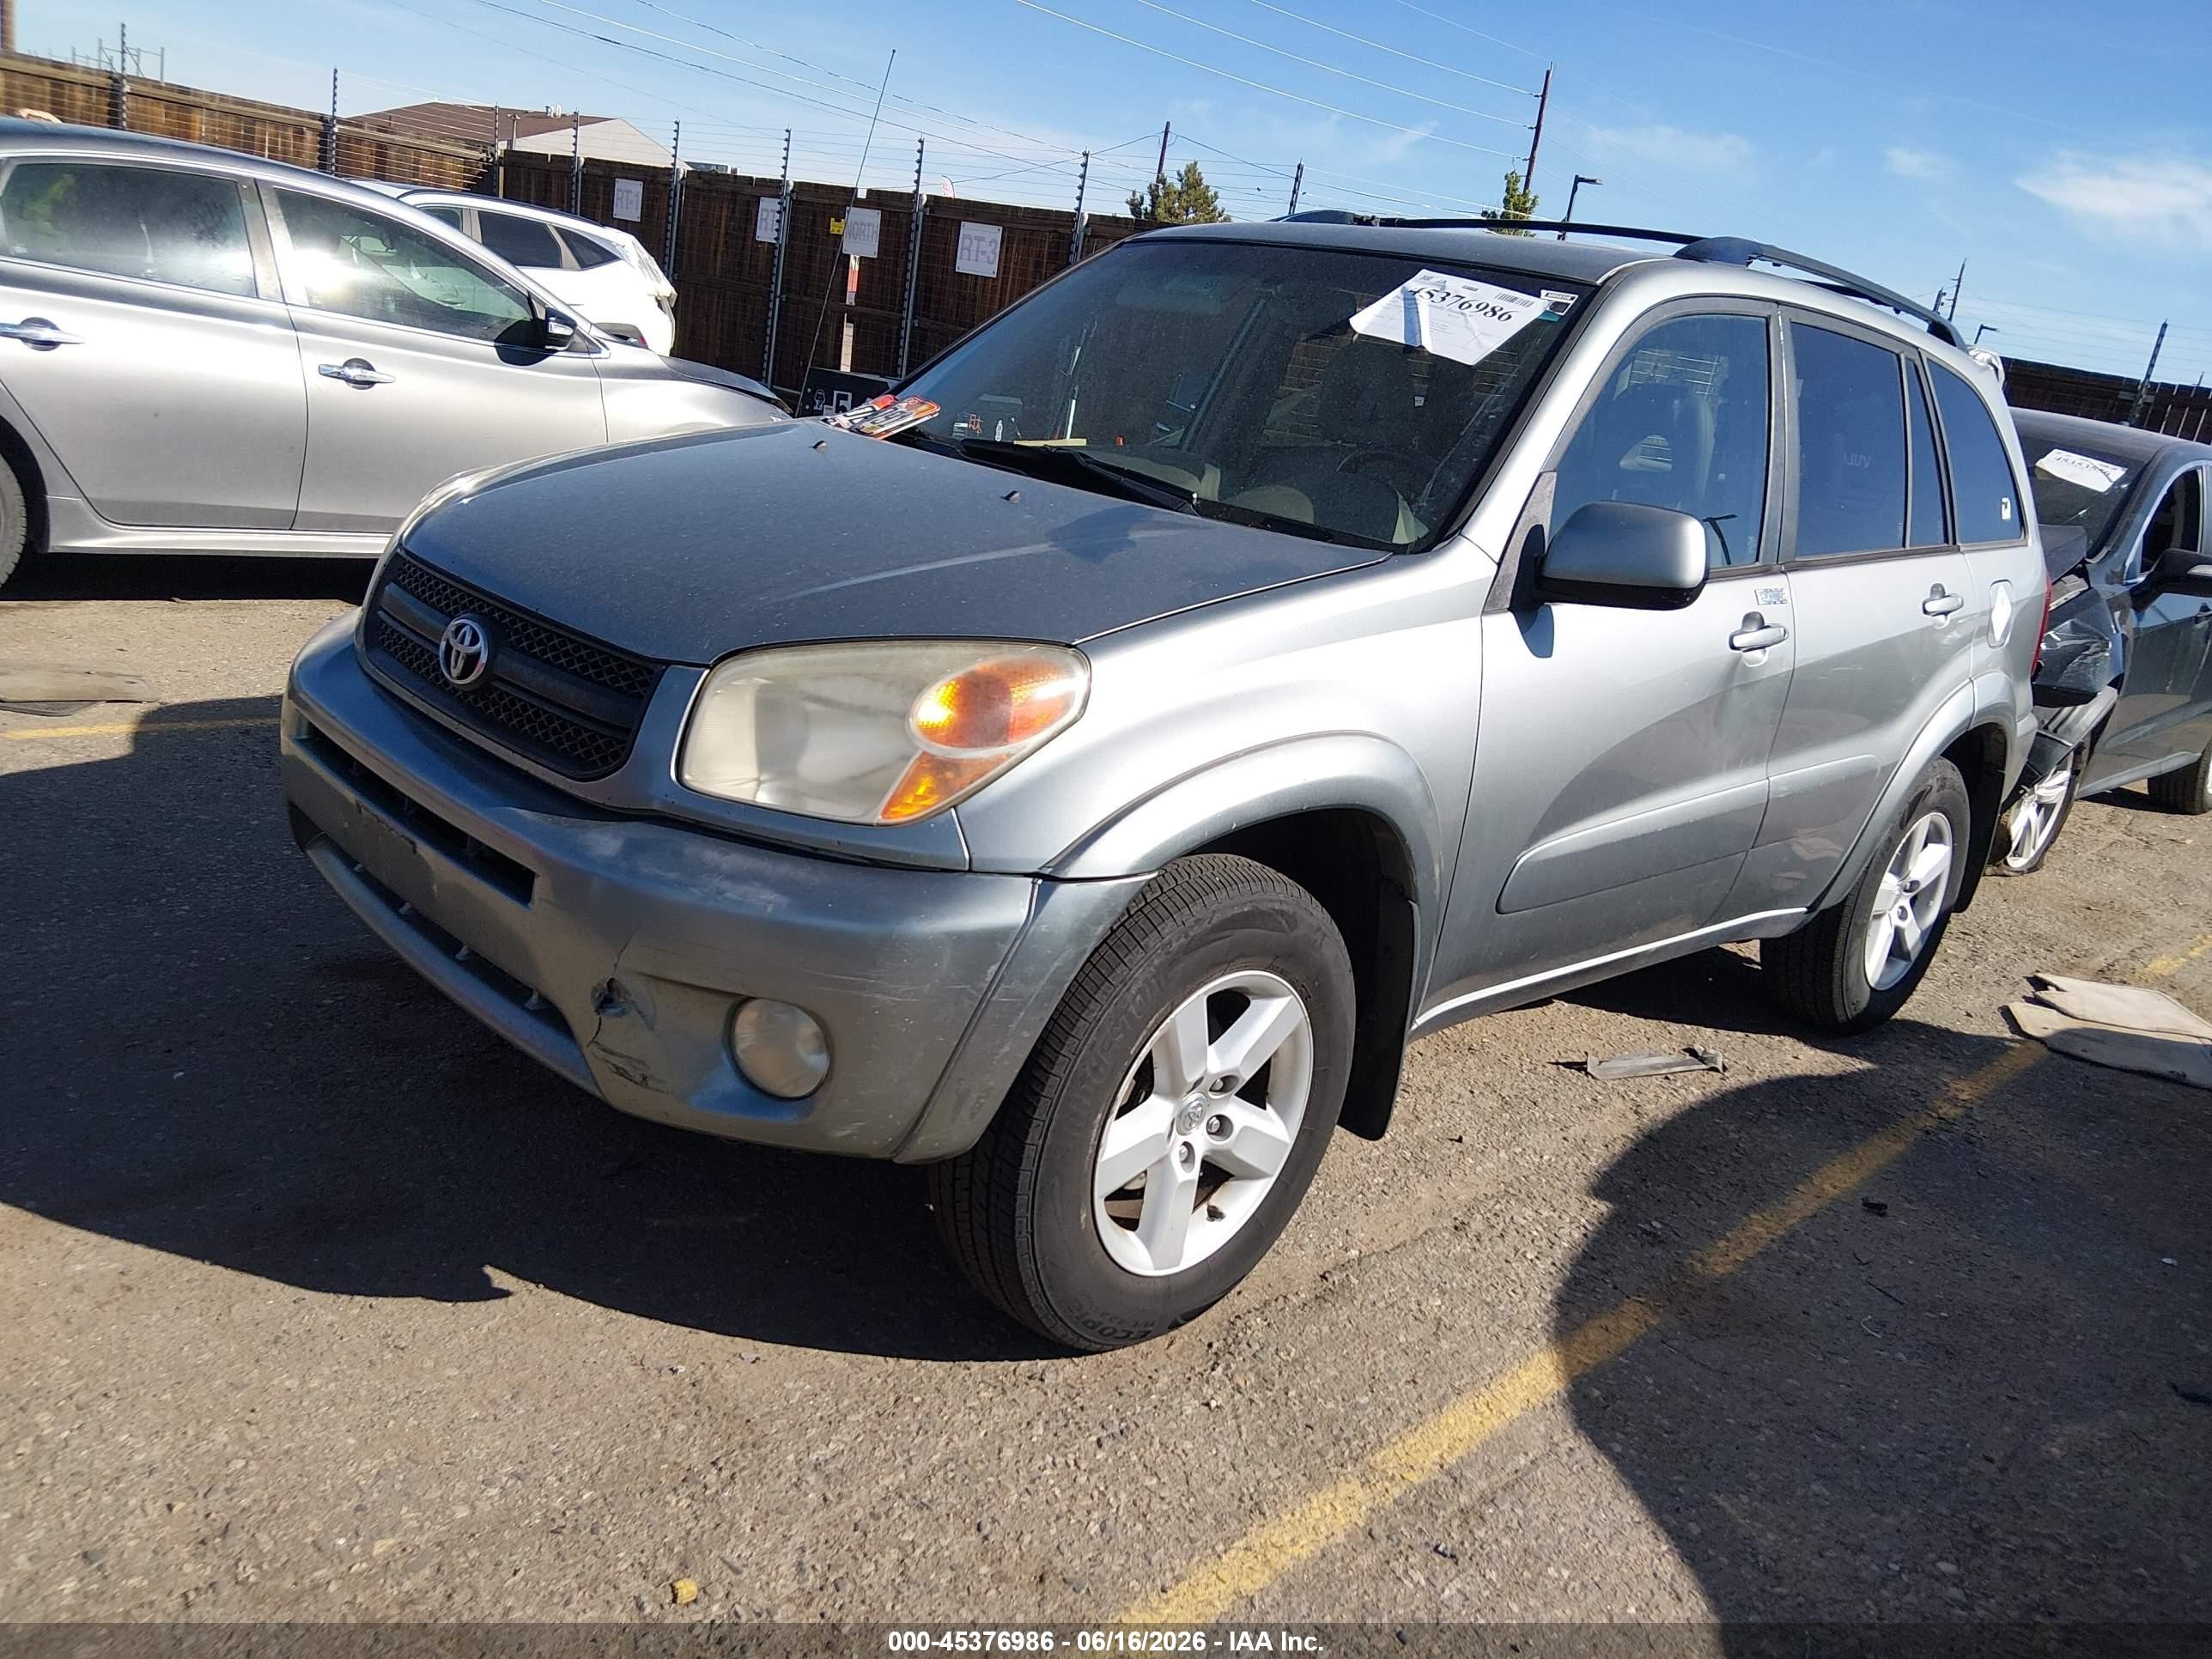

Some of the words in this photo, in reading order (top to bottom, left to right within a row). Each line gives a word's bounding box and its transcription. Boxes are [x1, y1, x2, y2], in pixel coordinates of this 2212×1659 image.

[845, 220, 878, 242] NORTH
[959, 234, 998, 264] RT-3
[1408, 287, 1519, 322] 45376986
